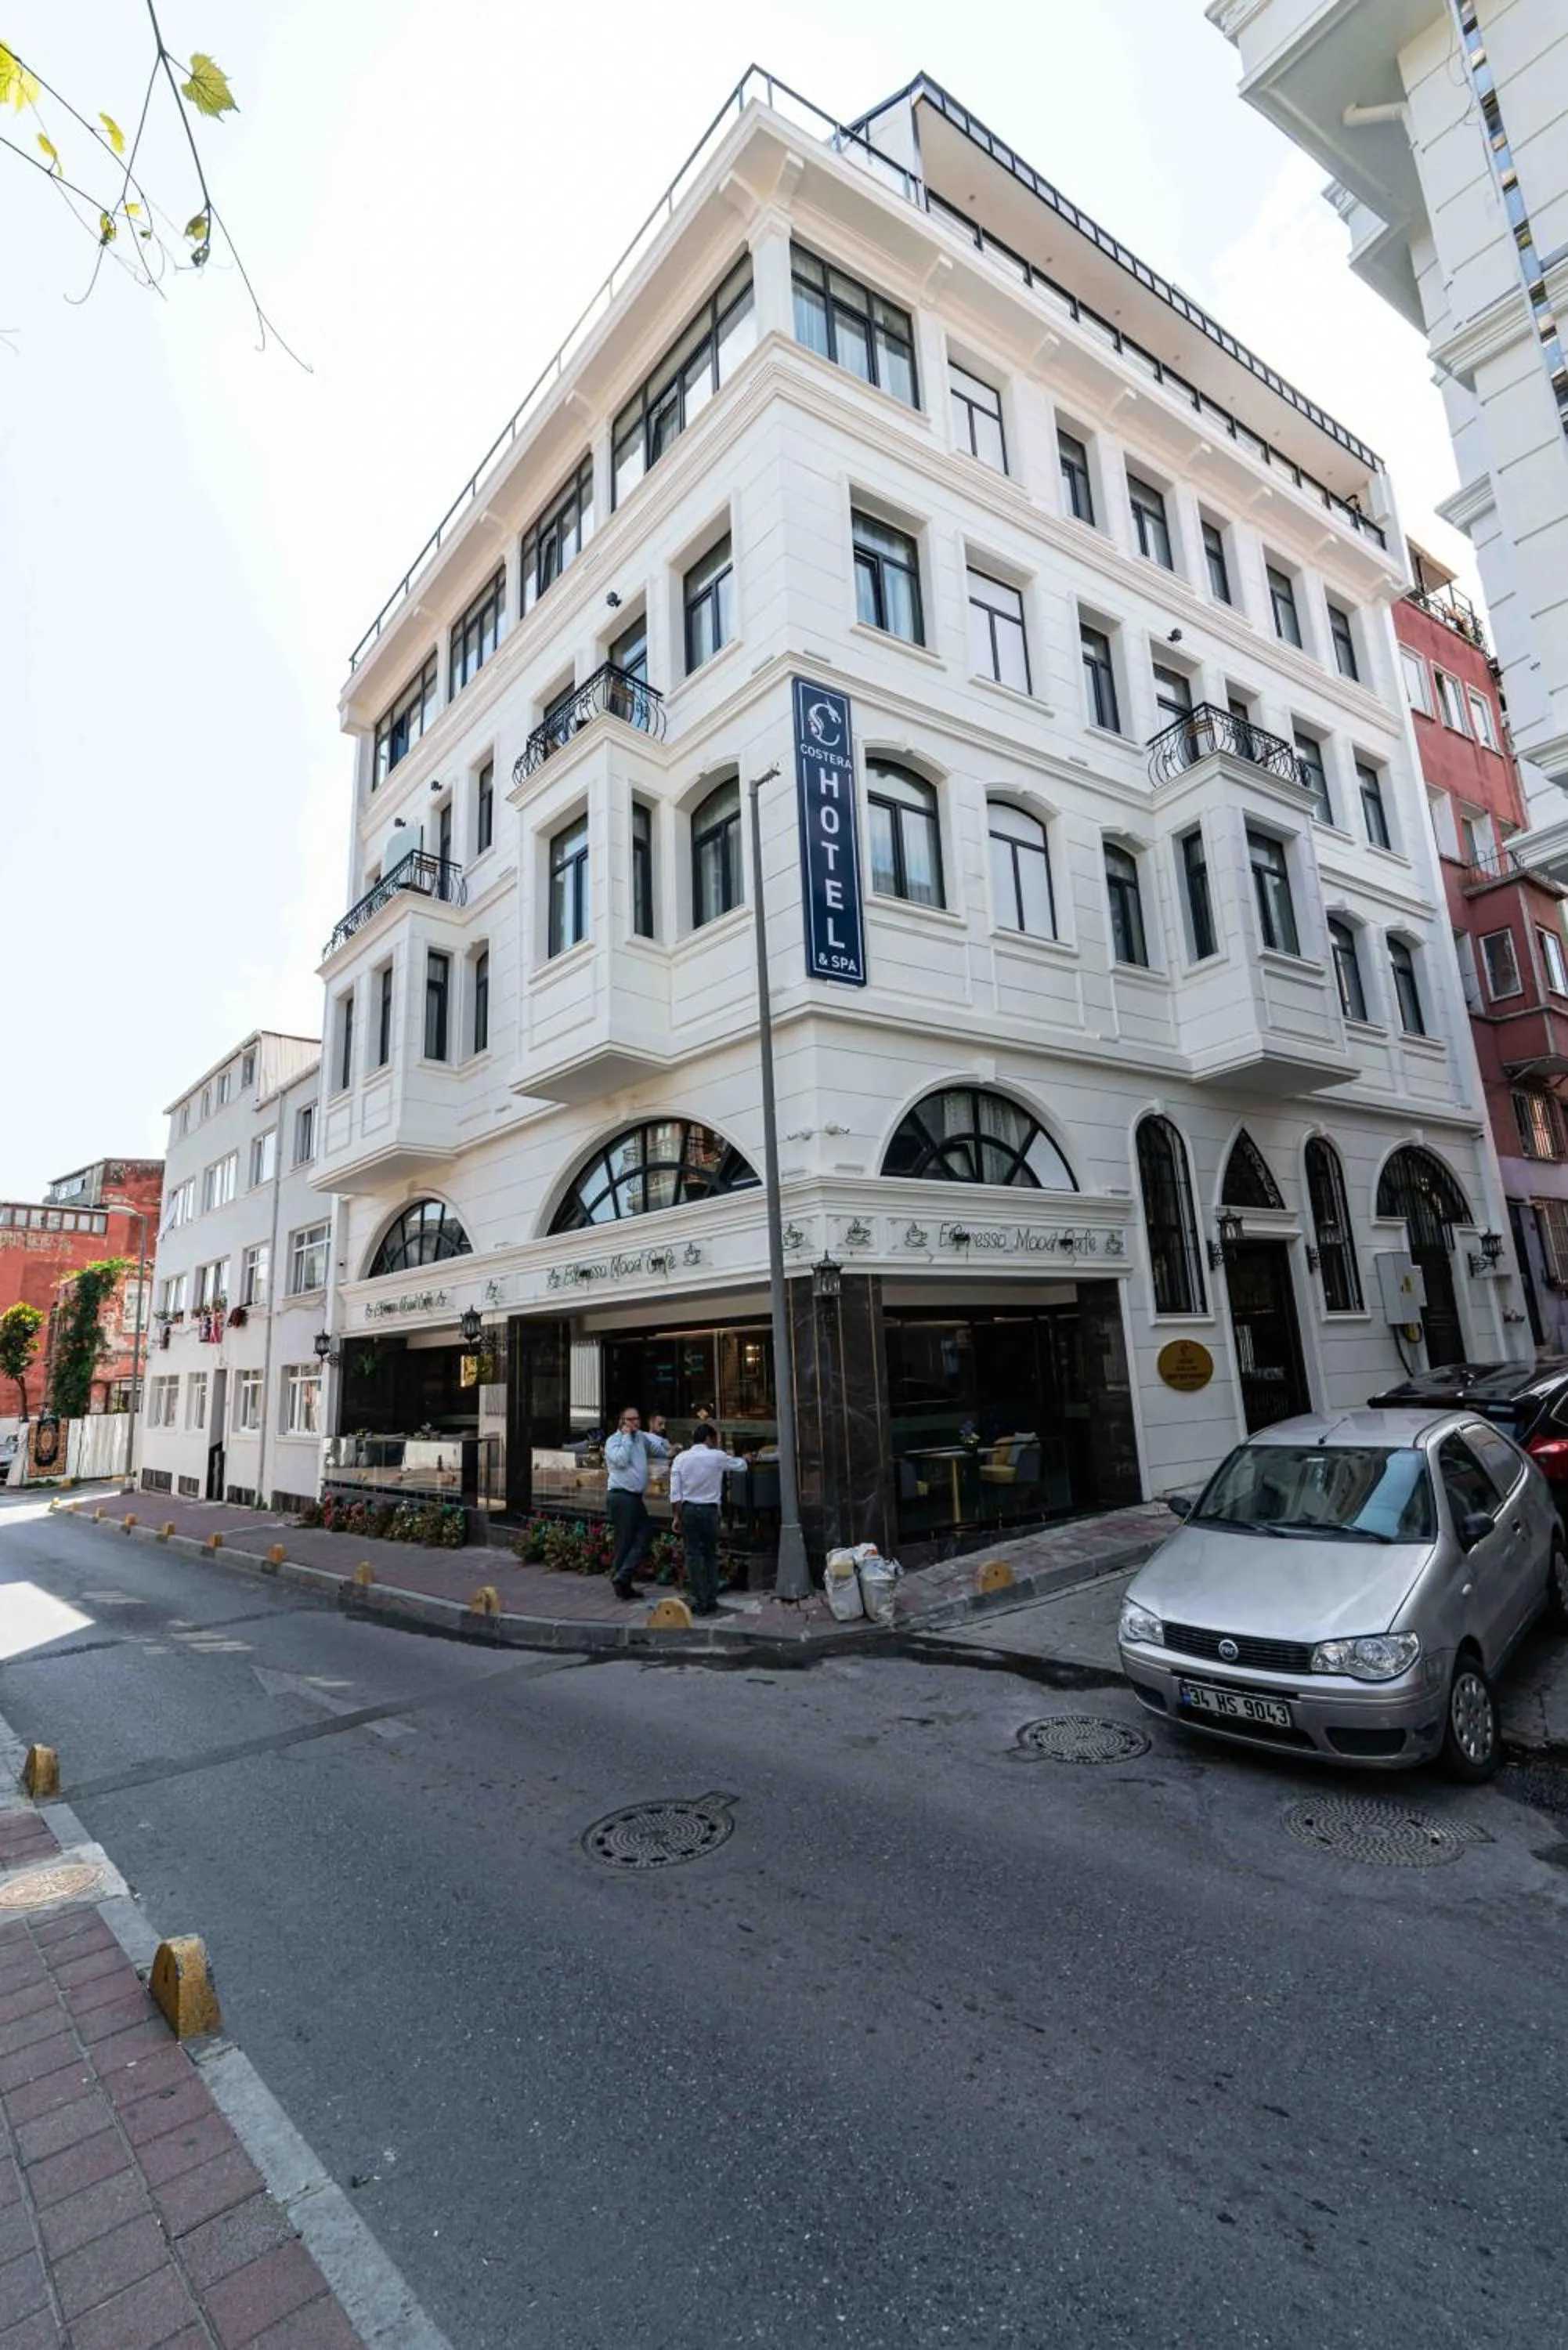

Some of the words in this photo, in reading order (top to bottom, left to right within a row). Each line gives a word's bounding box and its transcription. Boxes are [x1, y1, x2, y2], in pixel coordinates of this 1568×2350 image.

[800, 743, 853, 770] COSTERA
[818, 767, 845, 949] HOTEL
[818, 952, 828, 966] &
[831, 955, 858, 972] SPA
[1190, 1688, 1210, 1708] 34
[1216, 1692, 1237, 1715] HS
[1243, 1699, 1289, 1725] 9043
